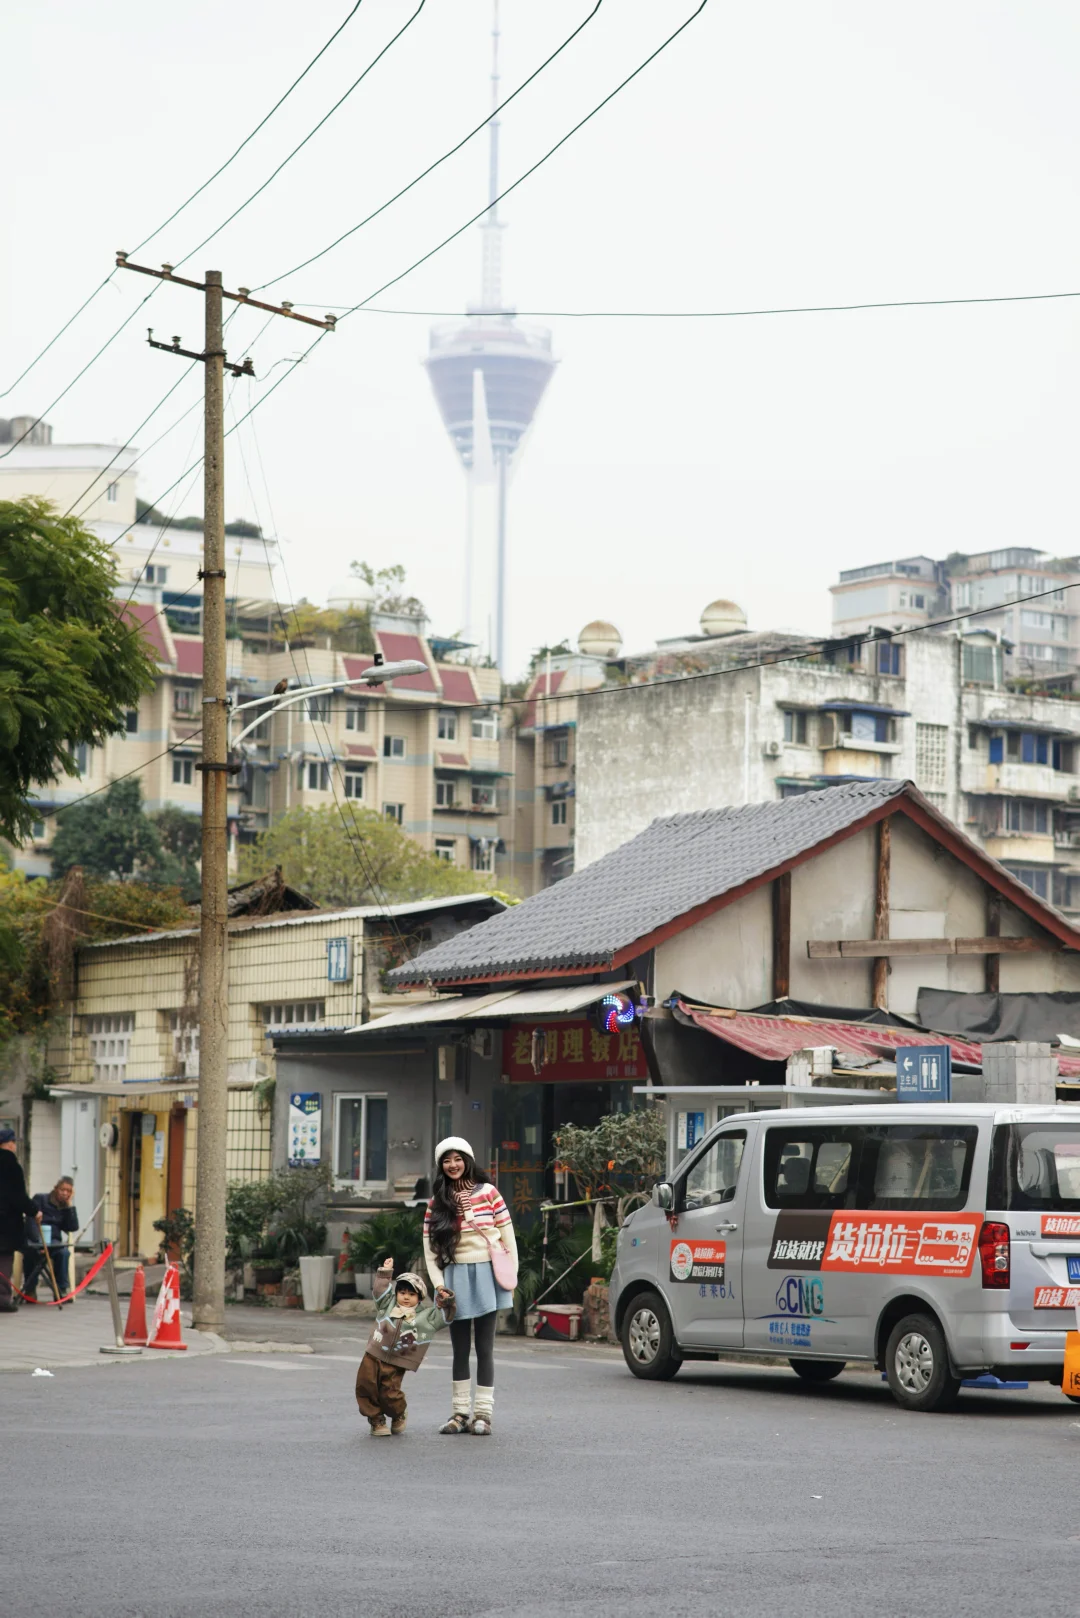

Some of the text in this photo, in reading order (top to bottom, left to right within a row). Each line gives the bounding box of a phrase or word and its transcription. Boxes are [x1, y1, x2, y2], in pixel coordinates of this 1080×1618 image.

[900, 1074, 923, 1086] 卫生间
[773, 1222, 911, 1267] 拉货就找 货拉拉
[786, 1278, 825, 1315] CNG
[1034, 1288, 1064, 1307] 拉货
